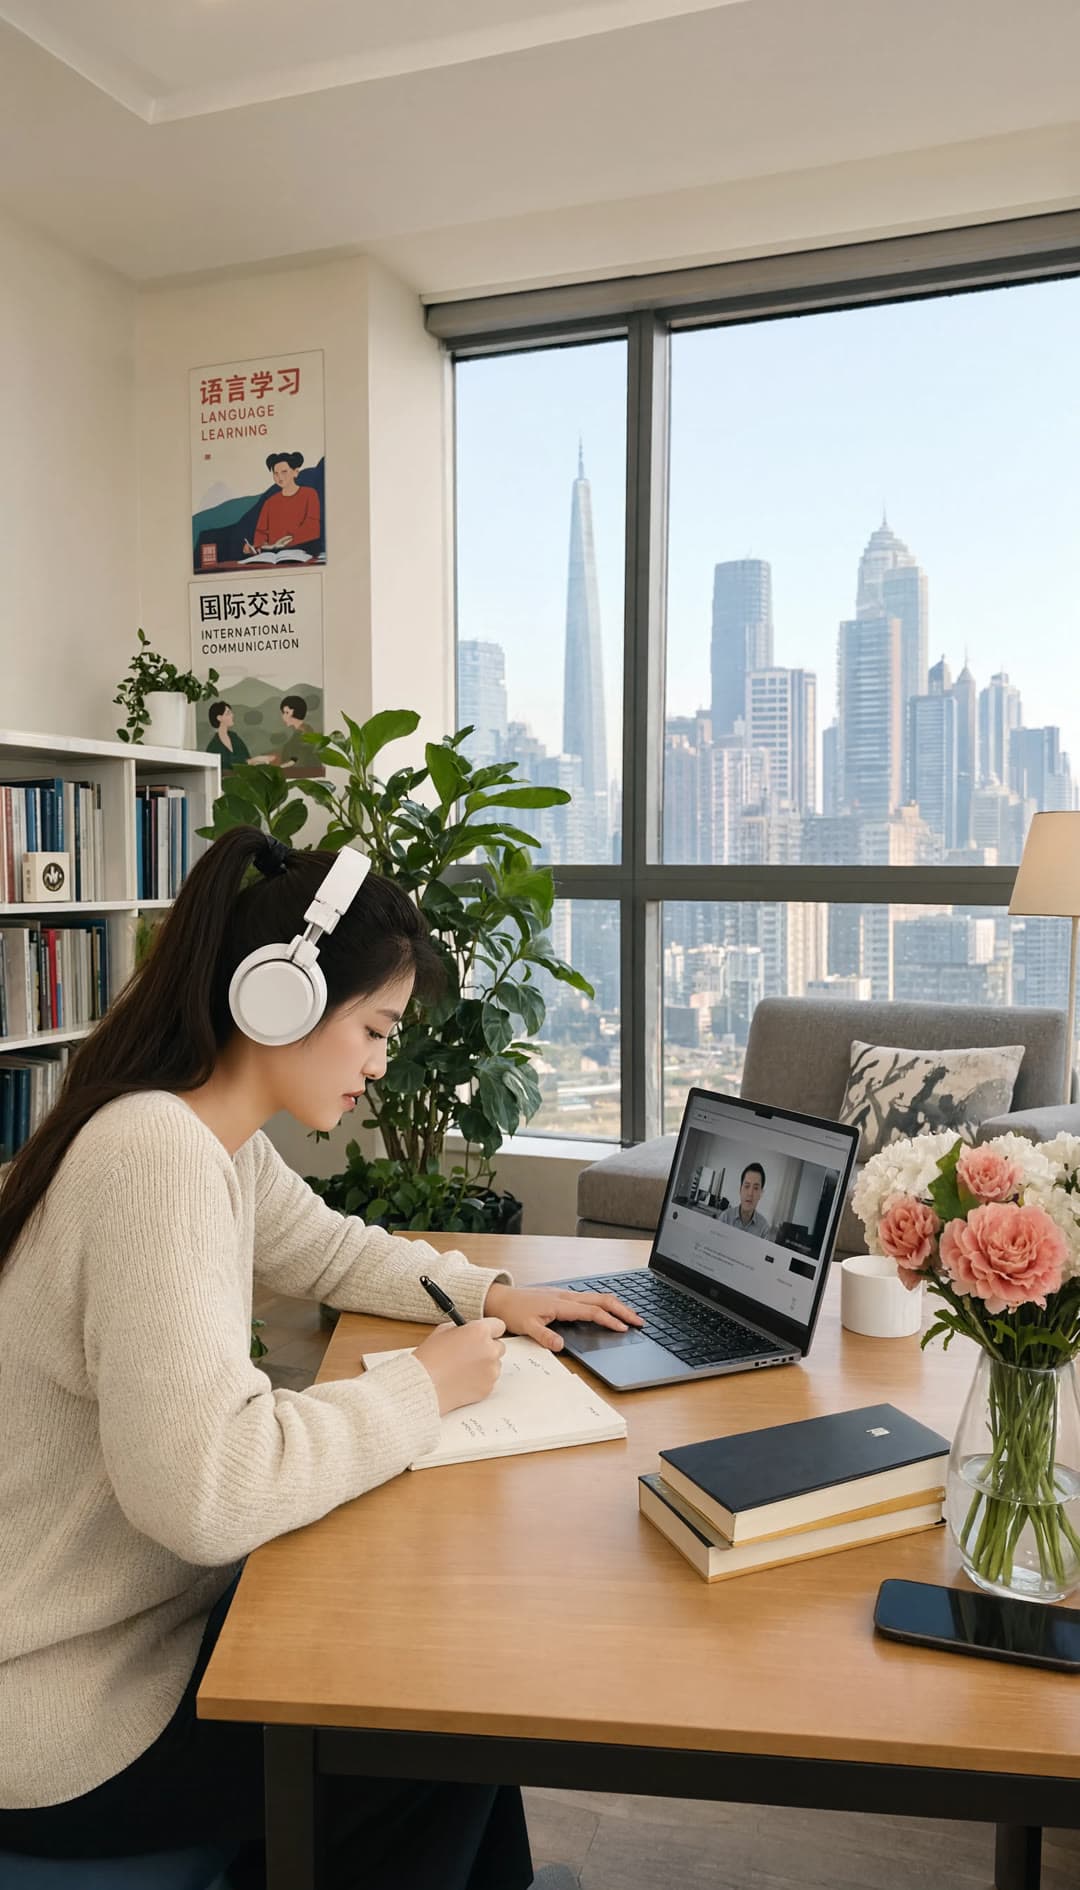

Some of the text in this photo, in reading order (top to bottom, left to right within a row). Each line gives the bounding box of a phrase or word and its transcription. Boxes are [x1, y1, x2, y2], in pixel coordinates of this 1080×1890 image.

[200, 367, 300, 405] 语言学习
[201, 405, 275, 424] LANGUAGE
[201, 424, 268, 441] LEARNING
[199, 588, 296, 622] 国际交流
[201, 623, 295, 640] INTERNATIONAL
[201, 639, 299, 655] COMMUNICATION
